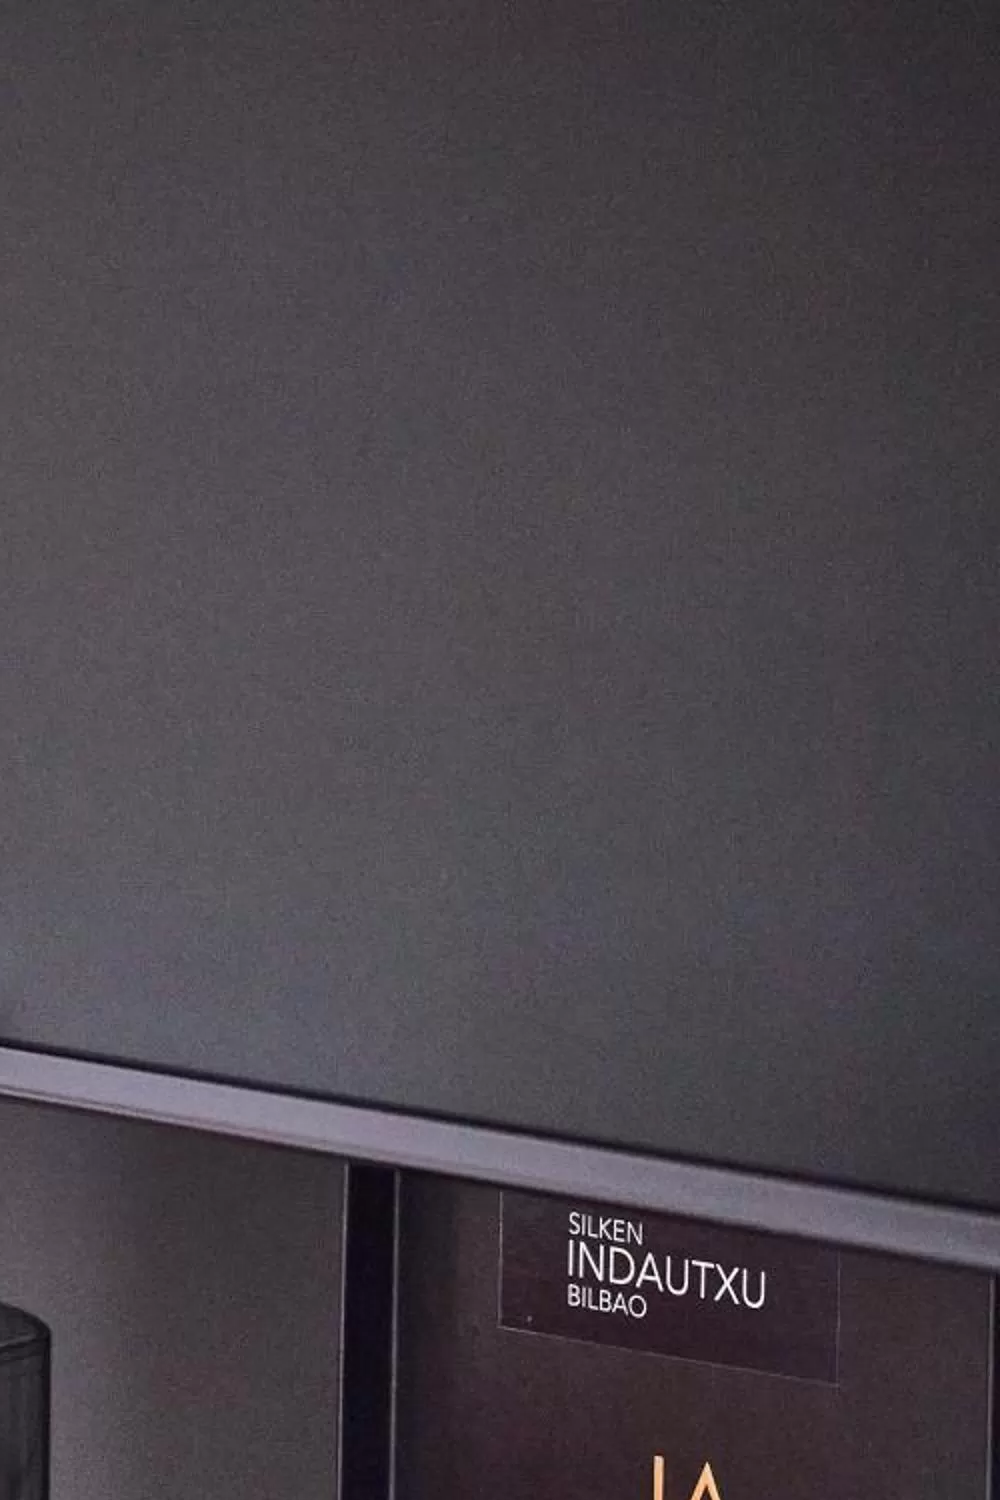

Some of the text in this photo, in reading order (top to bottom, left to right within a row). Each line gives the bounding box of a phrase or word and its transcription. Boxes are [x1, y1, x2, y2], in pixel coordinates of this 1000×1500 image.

[567, 1211, 644, 1246] SILKEN
[567, 1240, 767, 1310] INDAUTXU
[566, 1284, 648, 1319] BILBAO
